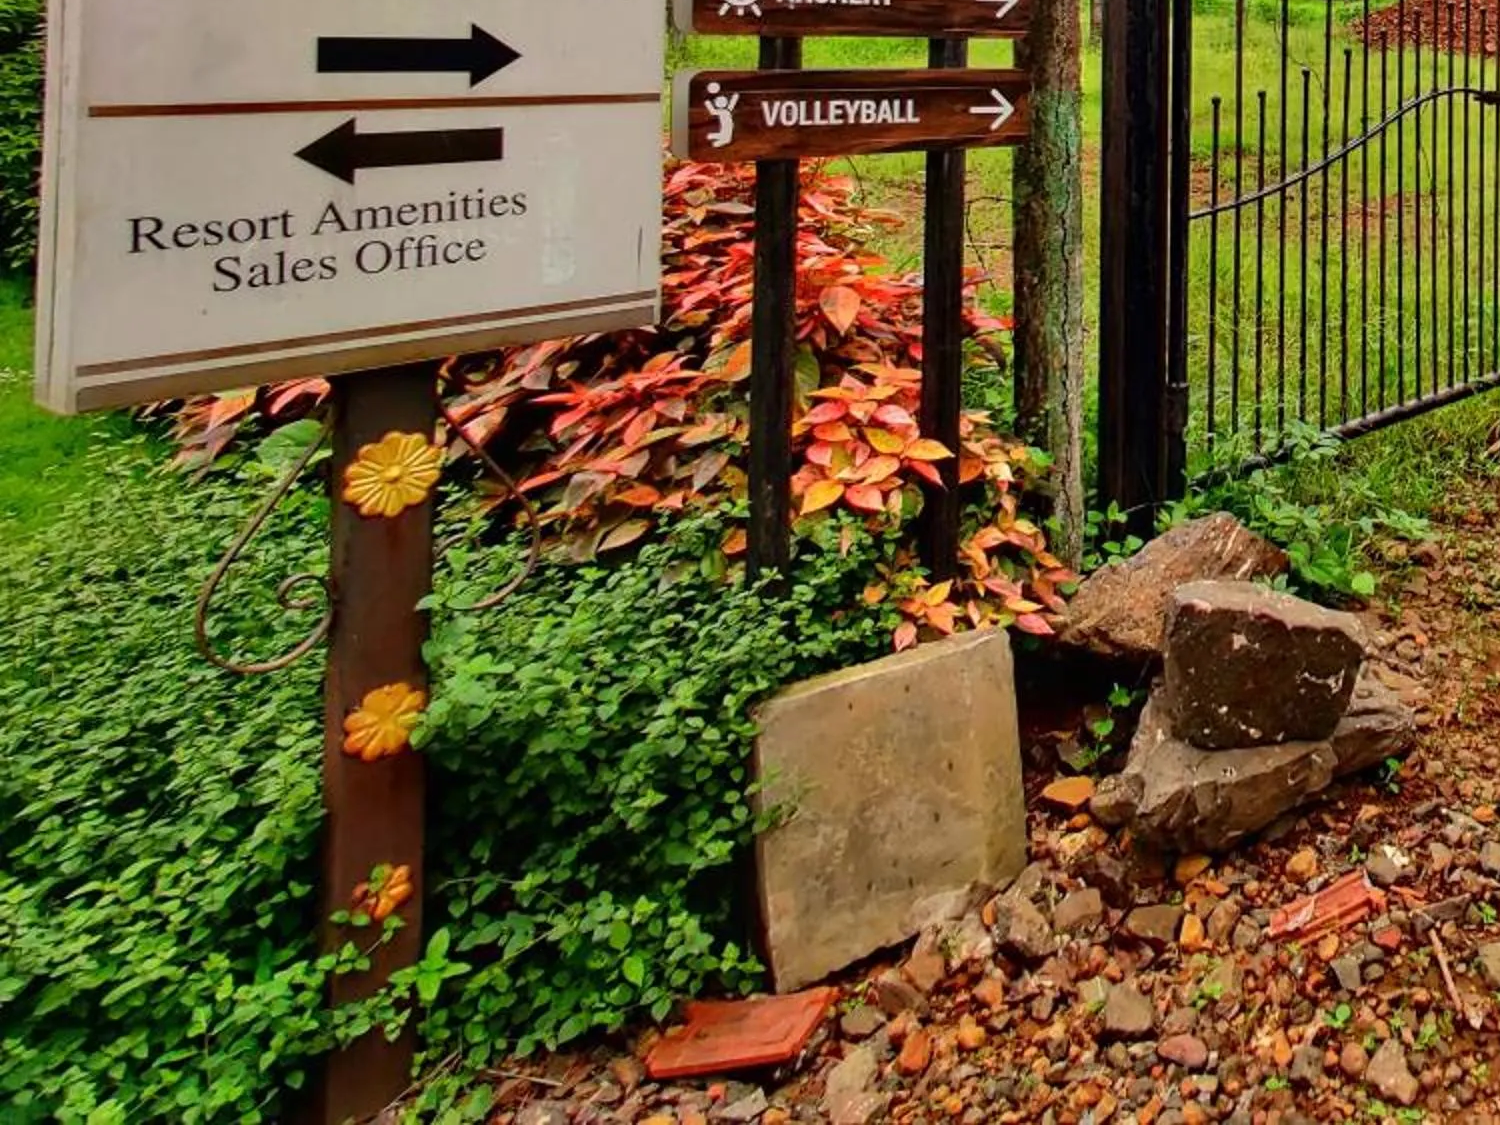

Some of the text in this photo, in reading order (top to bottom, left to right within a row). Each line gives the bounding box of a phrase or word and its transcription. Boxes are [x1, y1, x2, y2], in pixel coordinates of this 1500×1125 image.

[762, 99, 920, 127] VOLLEYBALL
[128, 188, 527, 254] Resort Amenities
[212, 234, 487, 293] Sales Office
